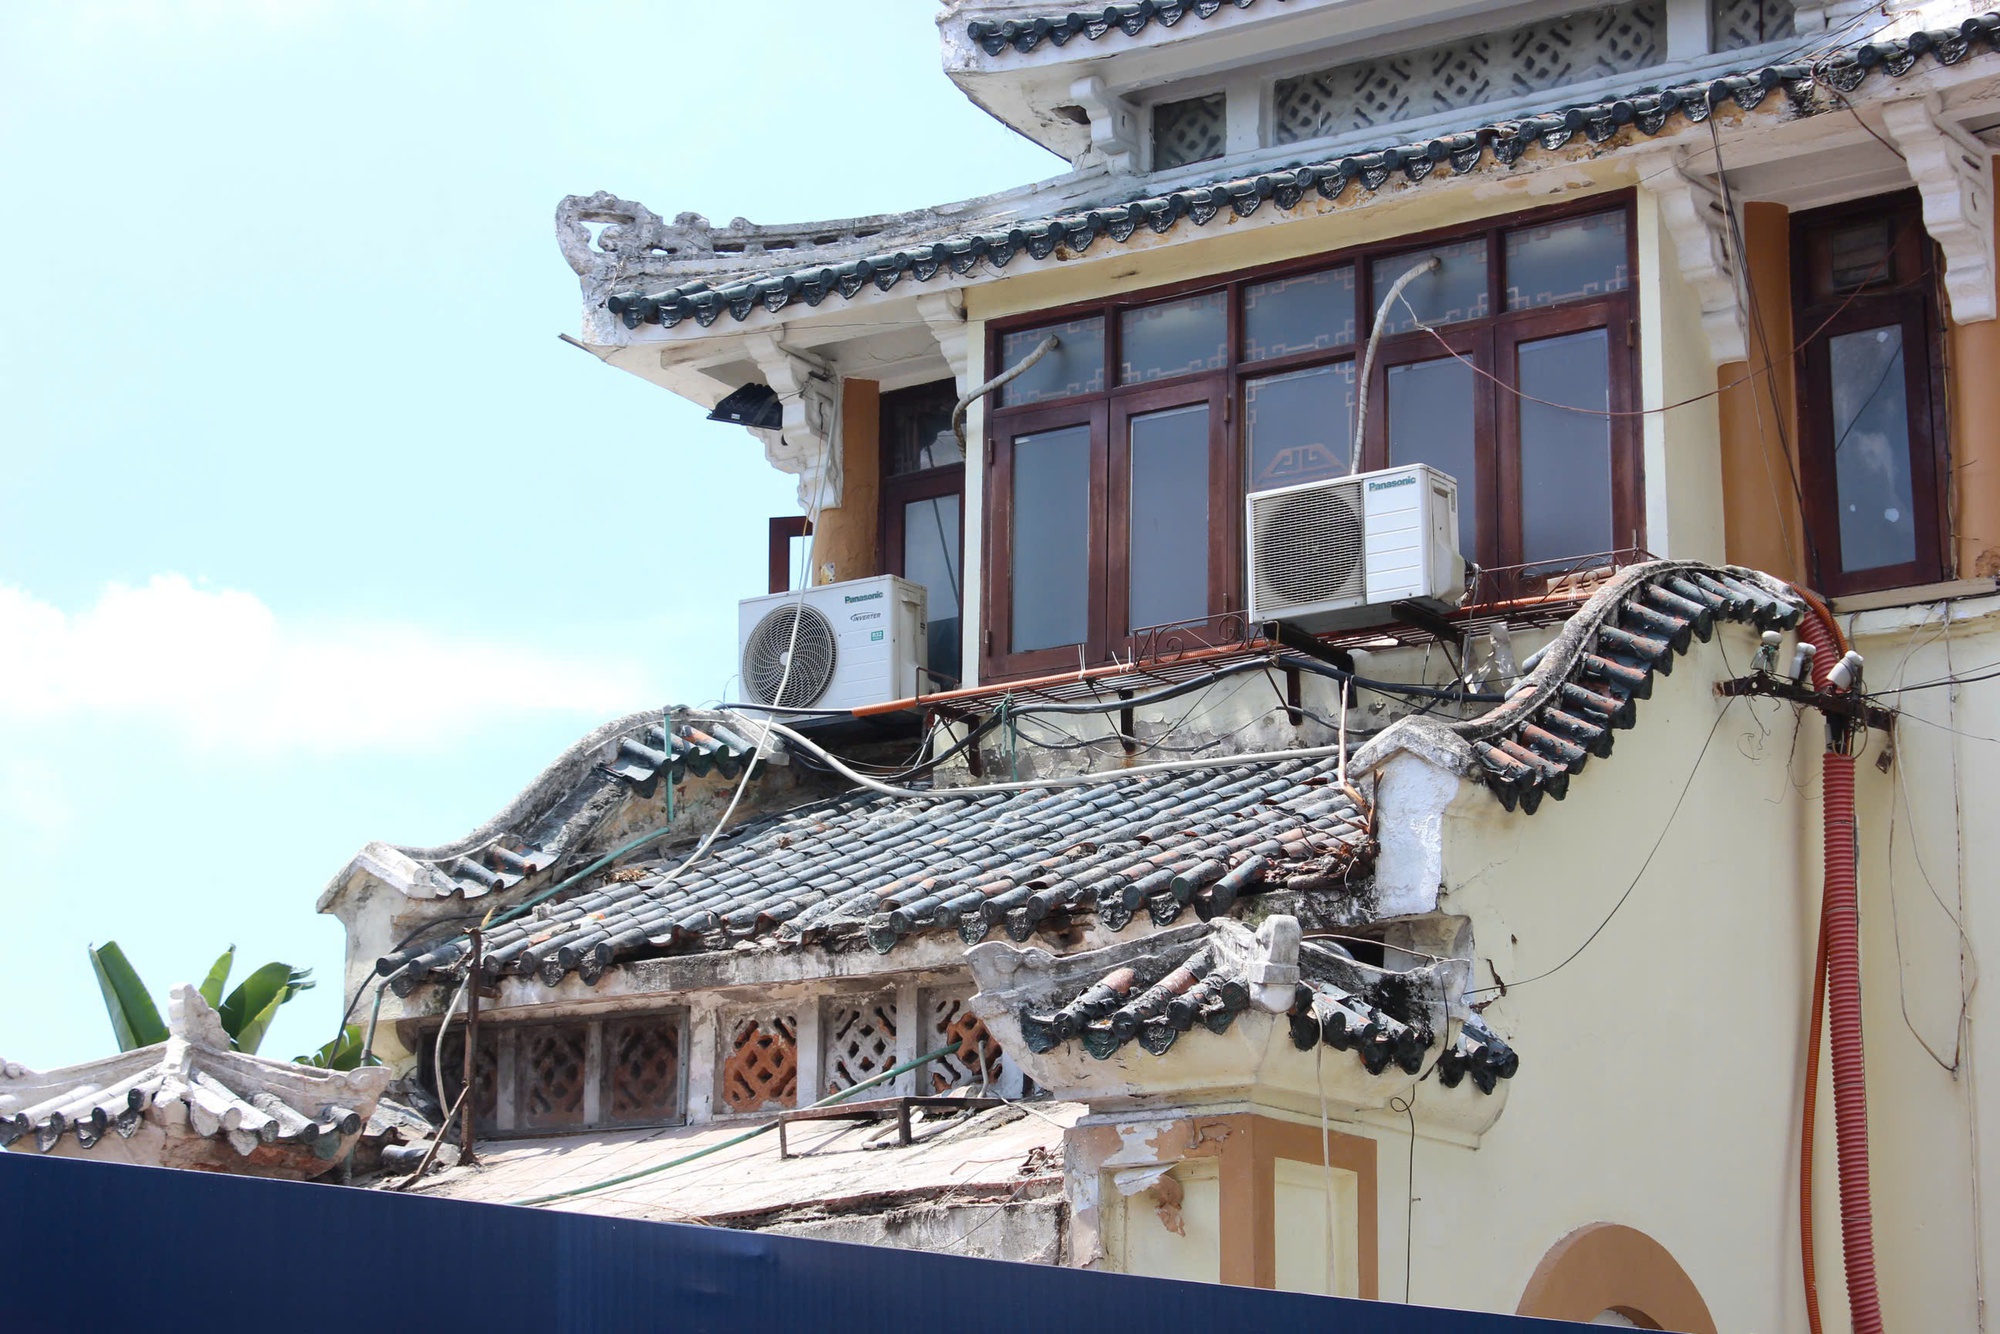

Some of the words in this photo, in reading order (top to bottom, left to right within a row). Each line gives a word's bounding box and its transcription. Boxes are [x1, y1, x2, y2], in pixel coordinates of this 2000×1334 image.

[1369, 476, 1416, 491] Panasonic
[845, 591, 883, 604] Panasonic
[852, 613, 881, 622] INVERTER
